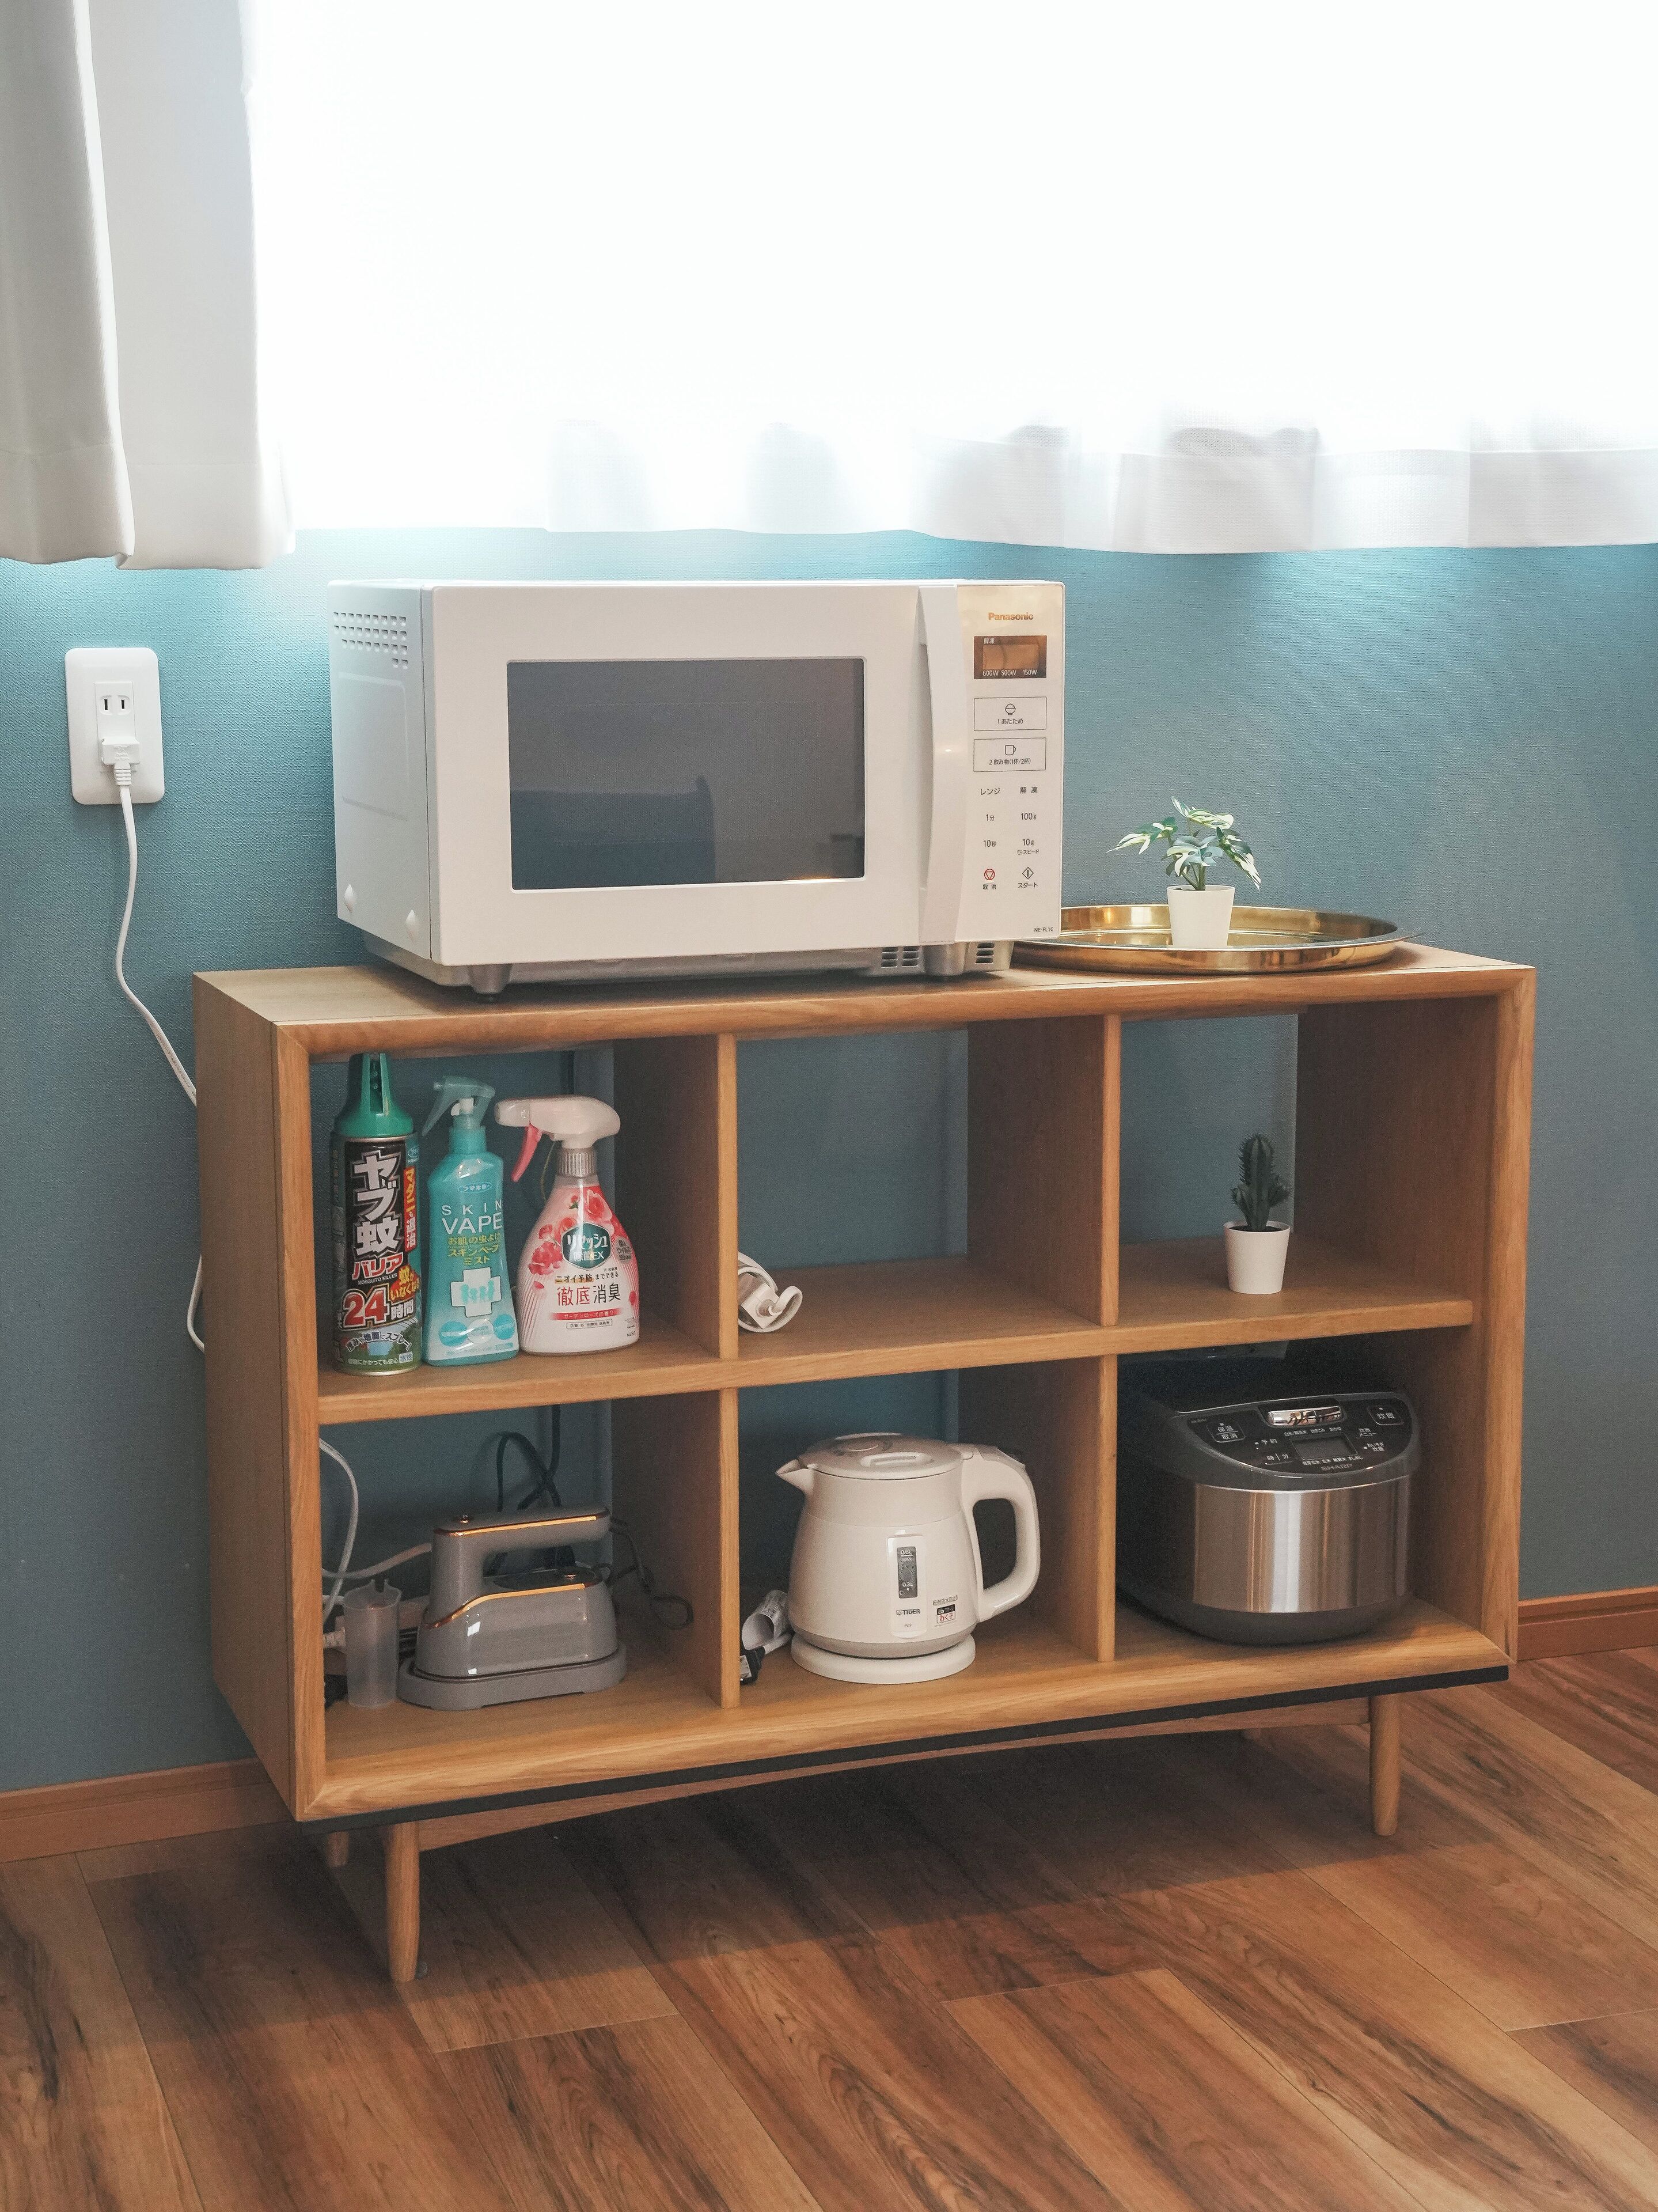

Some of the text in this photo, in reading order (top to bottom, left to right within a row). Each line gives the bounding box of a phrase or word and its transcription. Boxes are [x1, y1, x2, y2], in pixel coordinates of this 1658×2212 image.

[988, 612, 1034, 621] Panasonic
[983, 839, 996, 847] 10秒
[352, 1152, 400, 1257] ヤブ蚊
[442, 1199, 502, 1216] SKIN
[442, 1212, 503, 1235] VAPE
[352, 1252, 403, 1280] バリア
[358, 1273, 397, 1285] MOSQUITO KILLER
[556, 1274, 593, 1283] ニオイ予防
[557, 1282, 621, 1306] 徹底消臭
